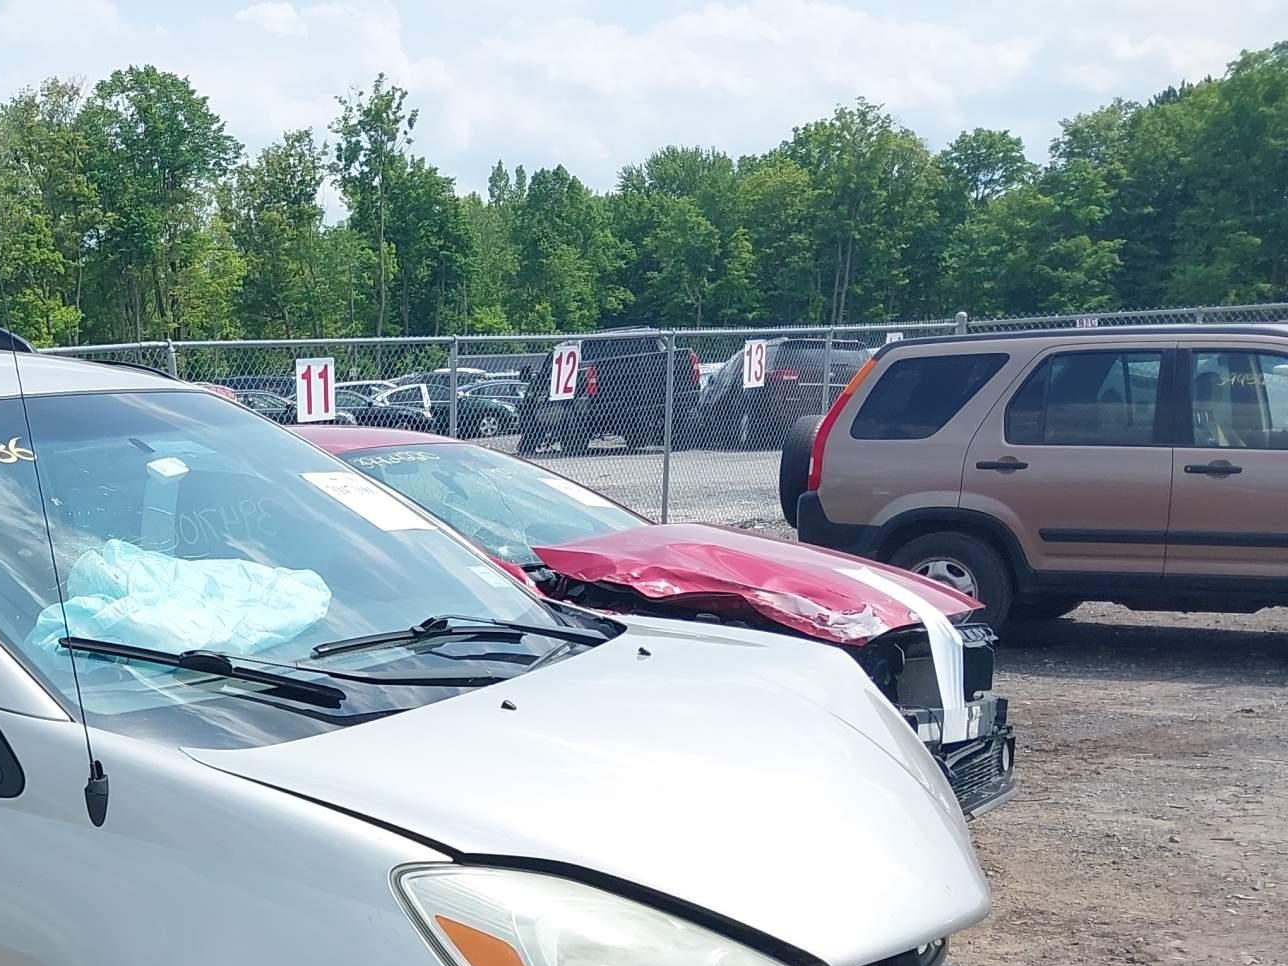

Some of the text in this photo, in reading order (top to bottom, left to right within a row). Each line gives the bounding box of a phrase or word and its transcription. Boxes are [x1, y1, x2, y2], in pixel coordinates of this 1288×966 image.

[554, 350, 578, 395] 12
[745, 343, 765, 383] 13
[300, 363, 331, 416] 11
